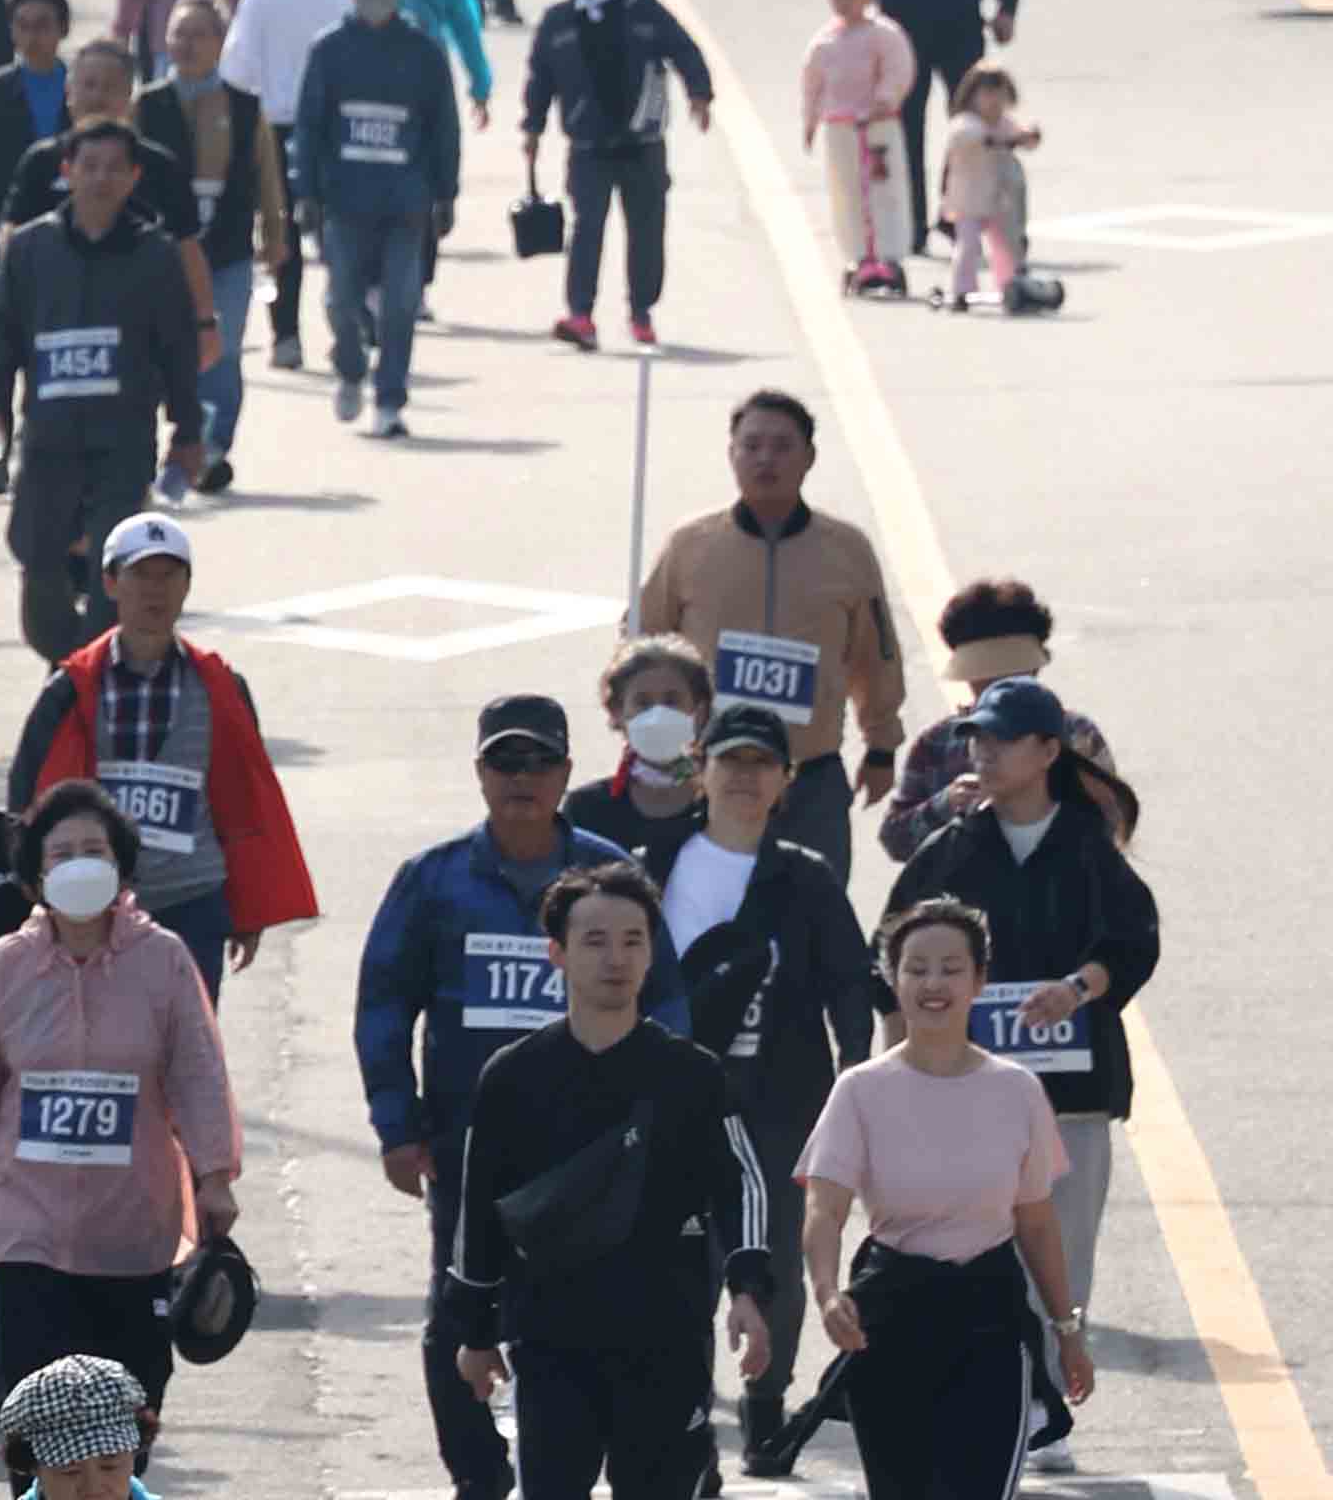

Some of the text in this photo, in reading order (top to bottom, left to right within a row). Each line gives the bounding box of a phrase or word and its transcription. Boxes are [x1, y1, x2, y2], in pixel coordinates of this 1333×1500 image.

[50, 349, 110, 377] 1454
[734, 656, 798, 699] 1031
[117, 785, 180, 826] 1661
[487, 962, 564, 1003] 1174
[40, 1096, 118, 1137] 1279
